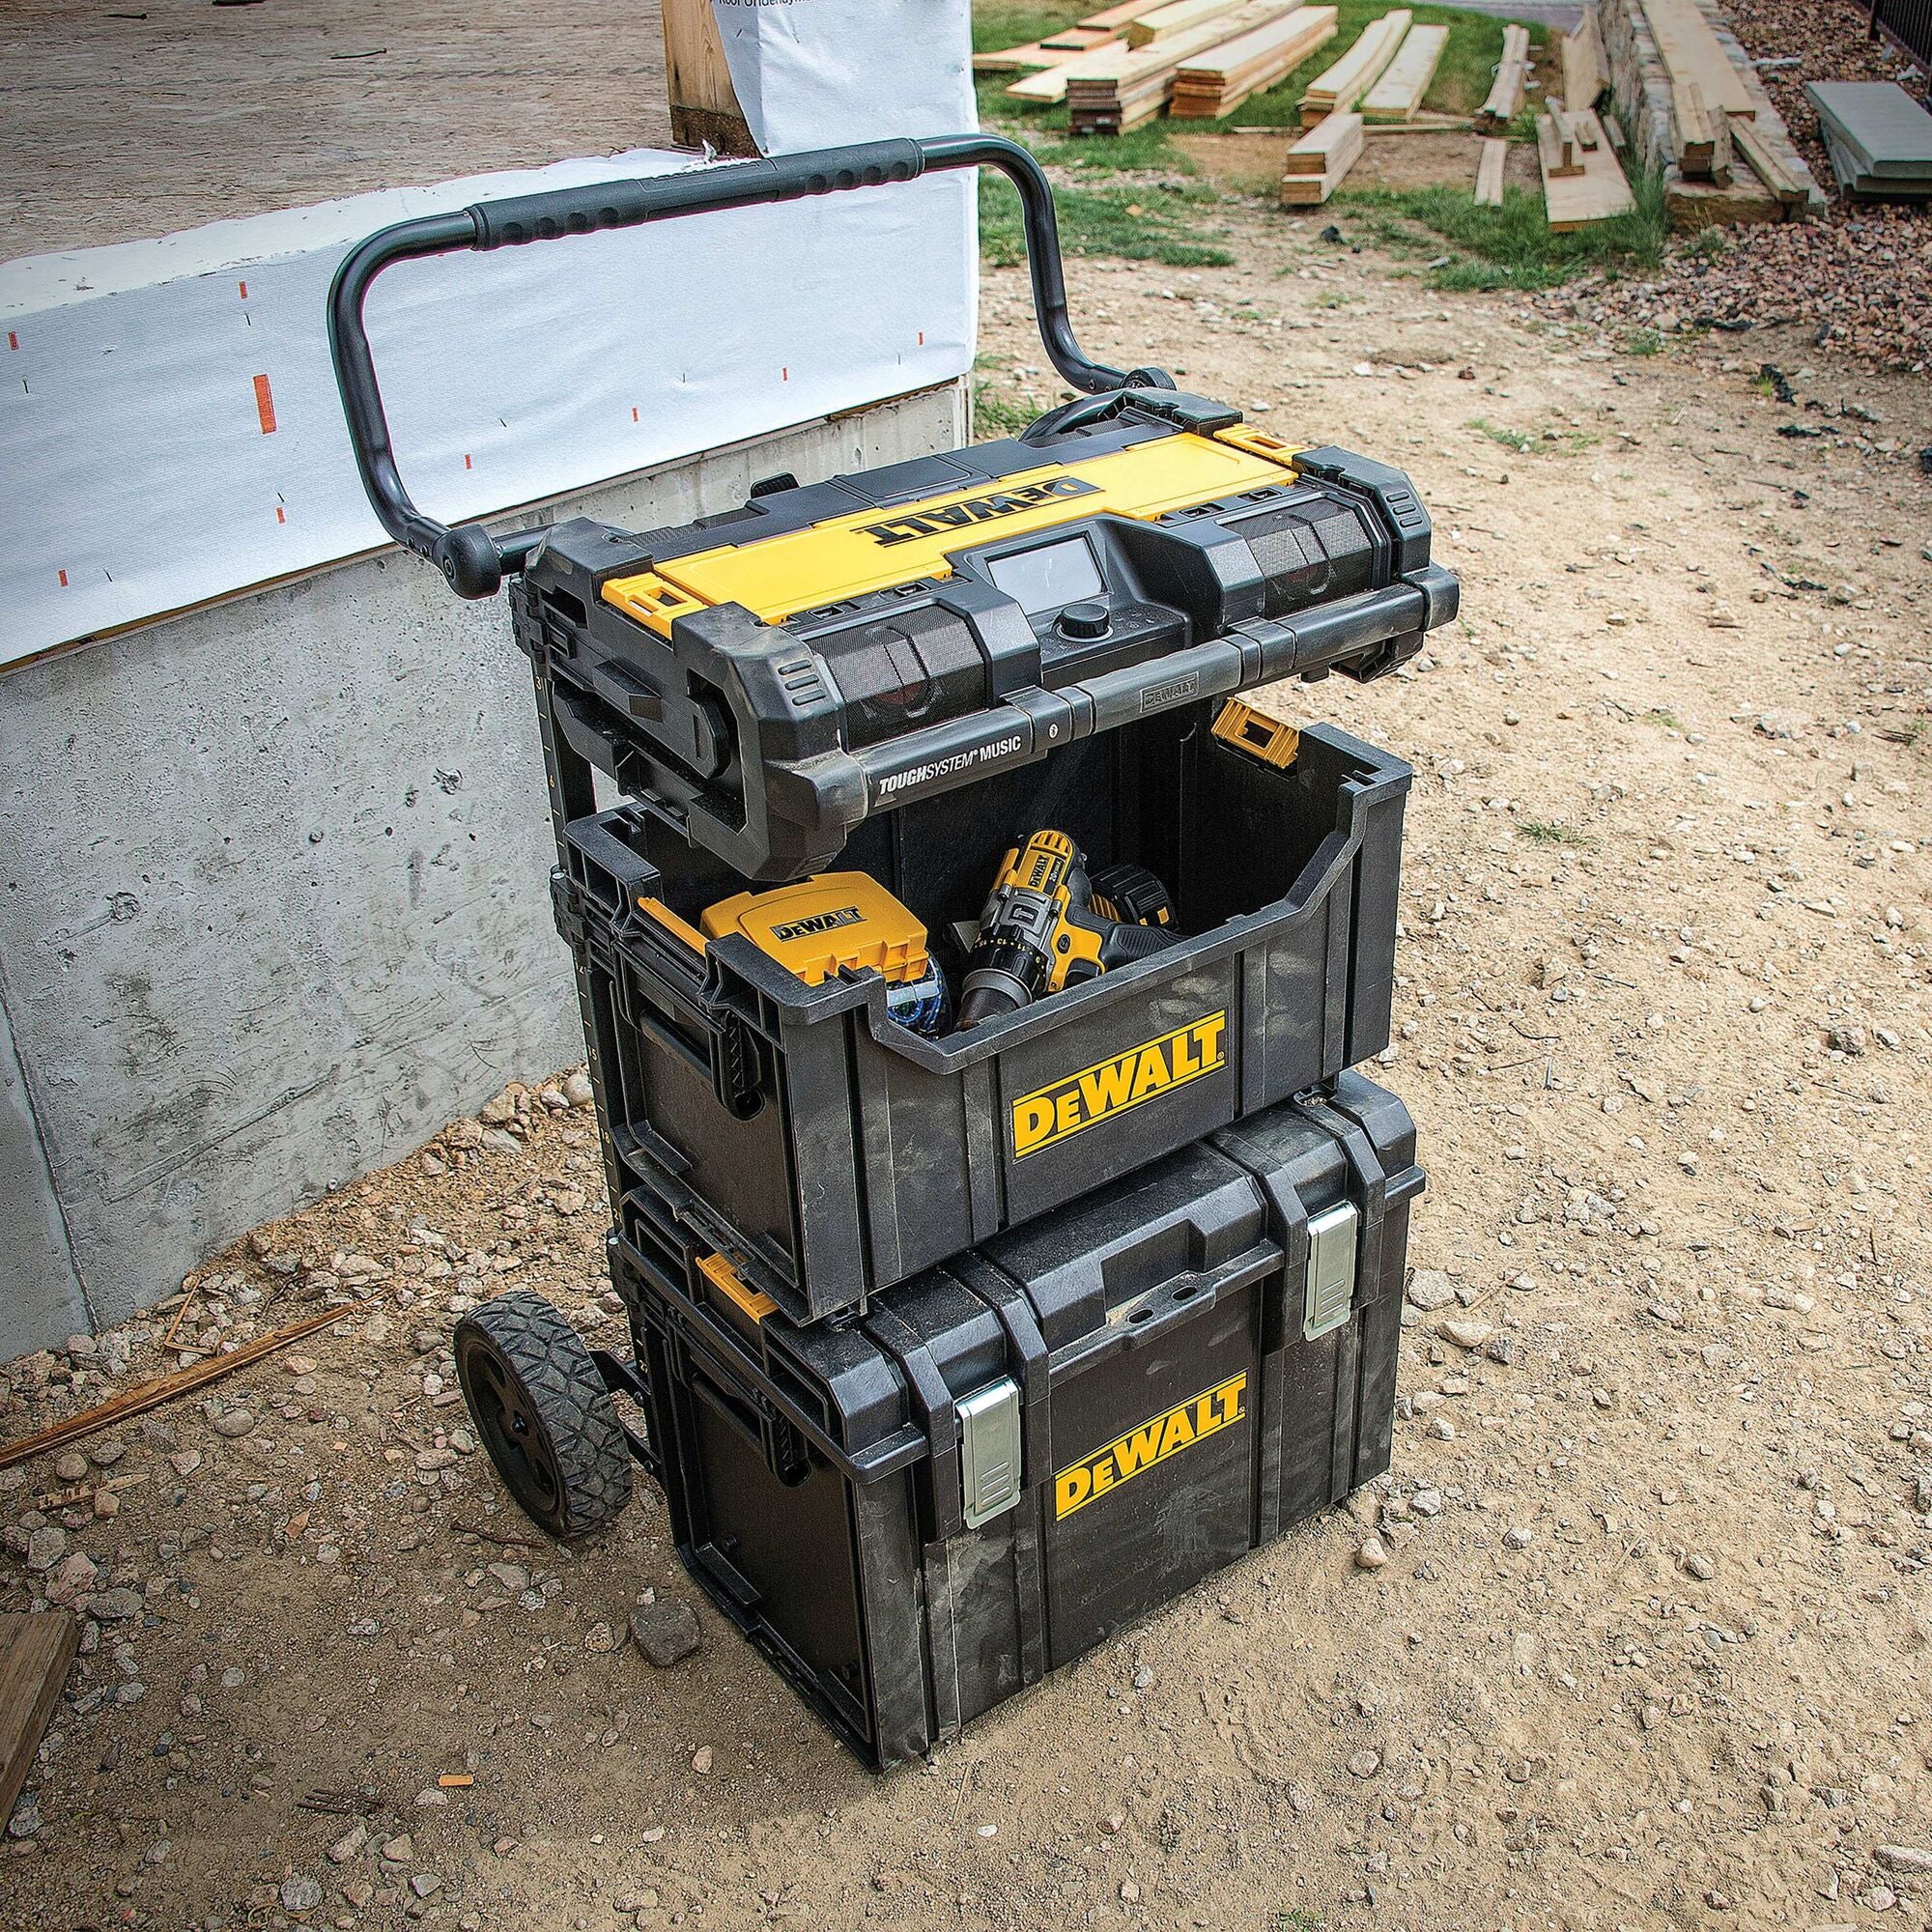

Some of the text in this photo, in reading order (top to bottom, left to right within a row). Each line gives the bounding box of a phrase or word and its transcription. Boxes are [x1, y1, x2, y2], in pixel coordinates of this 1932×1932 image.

[864, 477, 1102, 546] DEWALT
[980, 735, 1022, 761] MUSIC
[774, 908, 863, 940] DEWALT
[1013, 1016, 1225, 1151] DEWALT
[1055, 1378, 1246, 1517] DEWALT
